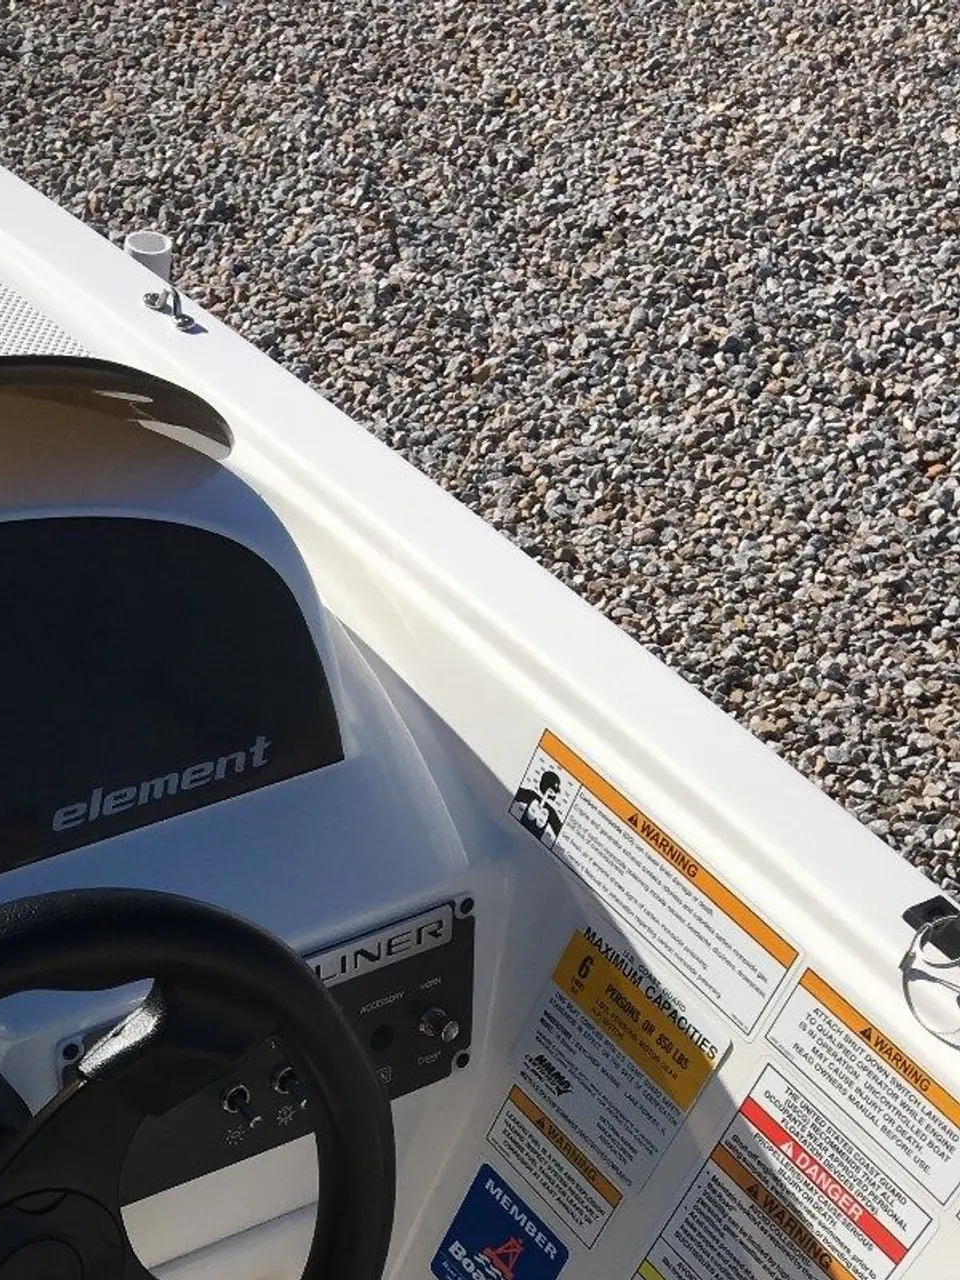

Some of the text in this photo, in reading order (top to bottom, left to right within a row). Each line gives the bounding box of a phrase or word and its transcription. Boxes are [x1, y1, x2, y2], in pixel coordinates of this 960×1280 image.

[52, 735, 271, 832] element
[638, 819, 700, 880] WARNING
[316, 918, 445, 983] LINER
[574, 952, 597, 981] 6
[582, 924, 643, 990] MAXIMUM
[643, 982, 718, 1062] CAPACITIES
[604, 982, 642, 1024] PERSONS
[640, 1018, 656, 1037] OR
[654, 1031, 674, 1055] 850
[670, 1047, 691, 1071] LBS
[791, 1041, 815, 1066] READ
[812, 1061, 848, 1097] OWNERS
[846, 1092, 881, 1128] MANUAL
[879, 1124, 914, 1158] BEFORE
[803, 1011, 818, 1026] TO
[815, 1021, 858, 1063] QUALIFIED
[855, 1058, 900, 1103] OPERATOR
[897, 1098, 926, 1126] WHILE
[923, 1122, 957, 1155] ENGINE
[810, 1044, 829, 1064] MAY
[826, 1060, 855, 1089] CAUSE
[853, 1085, 884, 1116] INJURY
[881, 1111, 896, 1128] OR
[812, 1005, 960, 1144] ATTACH SHUT DOWN SWITCH LANYARD
[871, 1034, 933, 1094] WARNING
[544, 1123, 598, 1182] WARNING
[783, 1085, 908, 1207] THE UNITED STATES COAST GUARD
[794, 1150, 864, 1223] DANGER
[483, 1177, 559, 1261] MEMBER
[760, 1193, 835, 1272] WARNING
